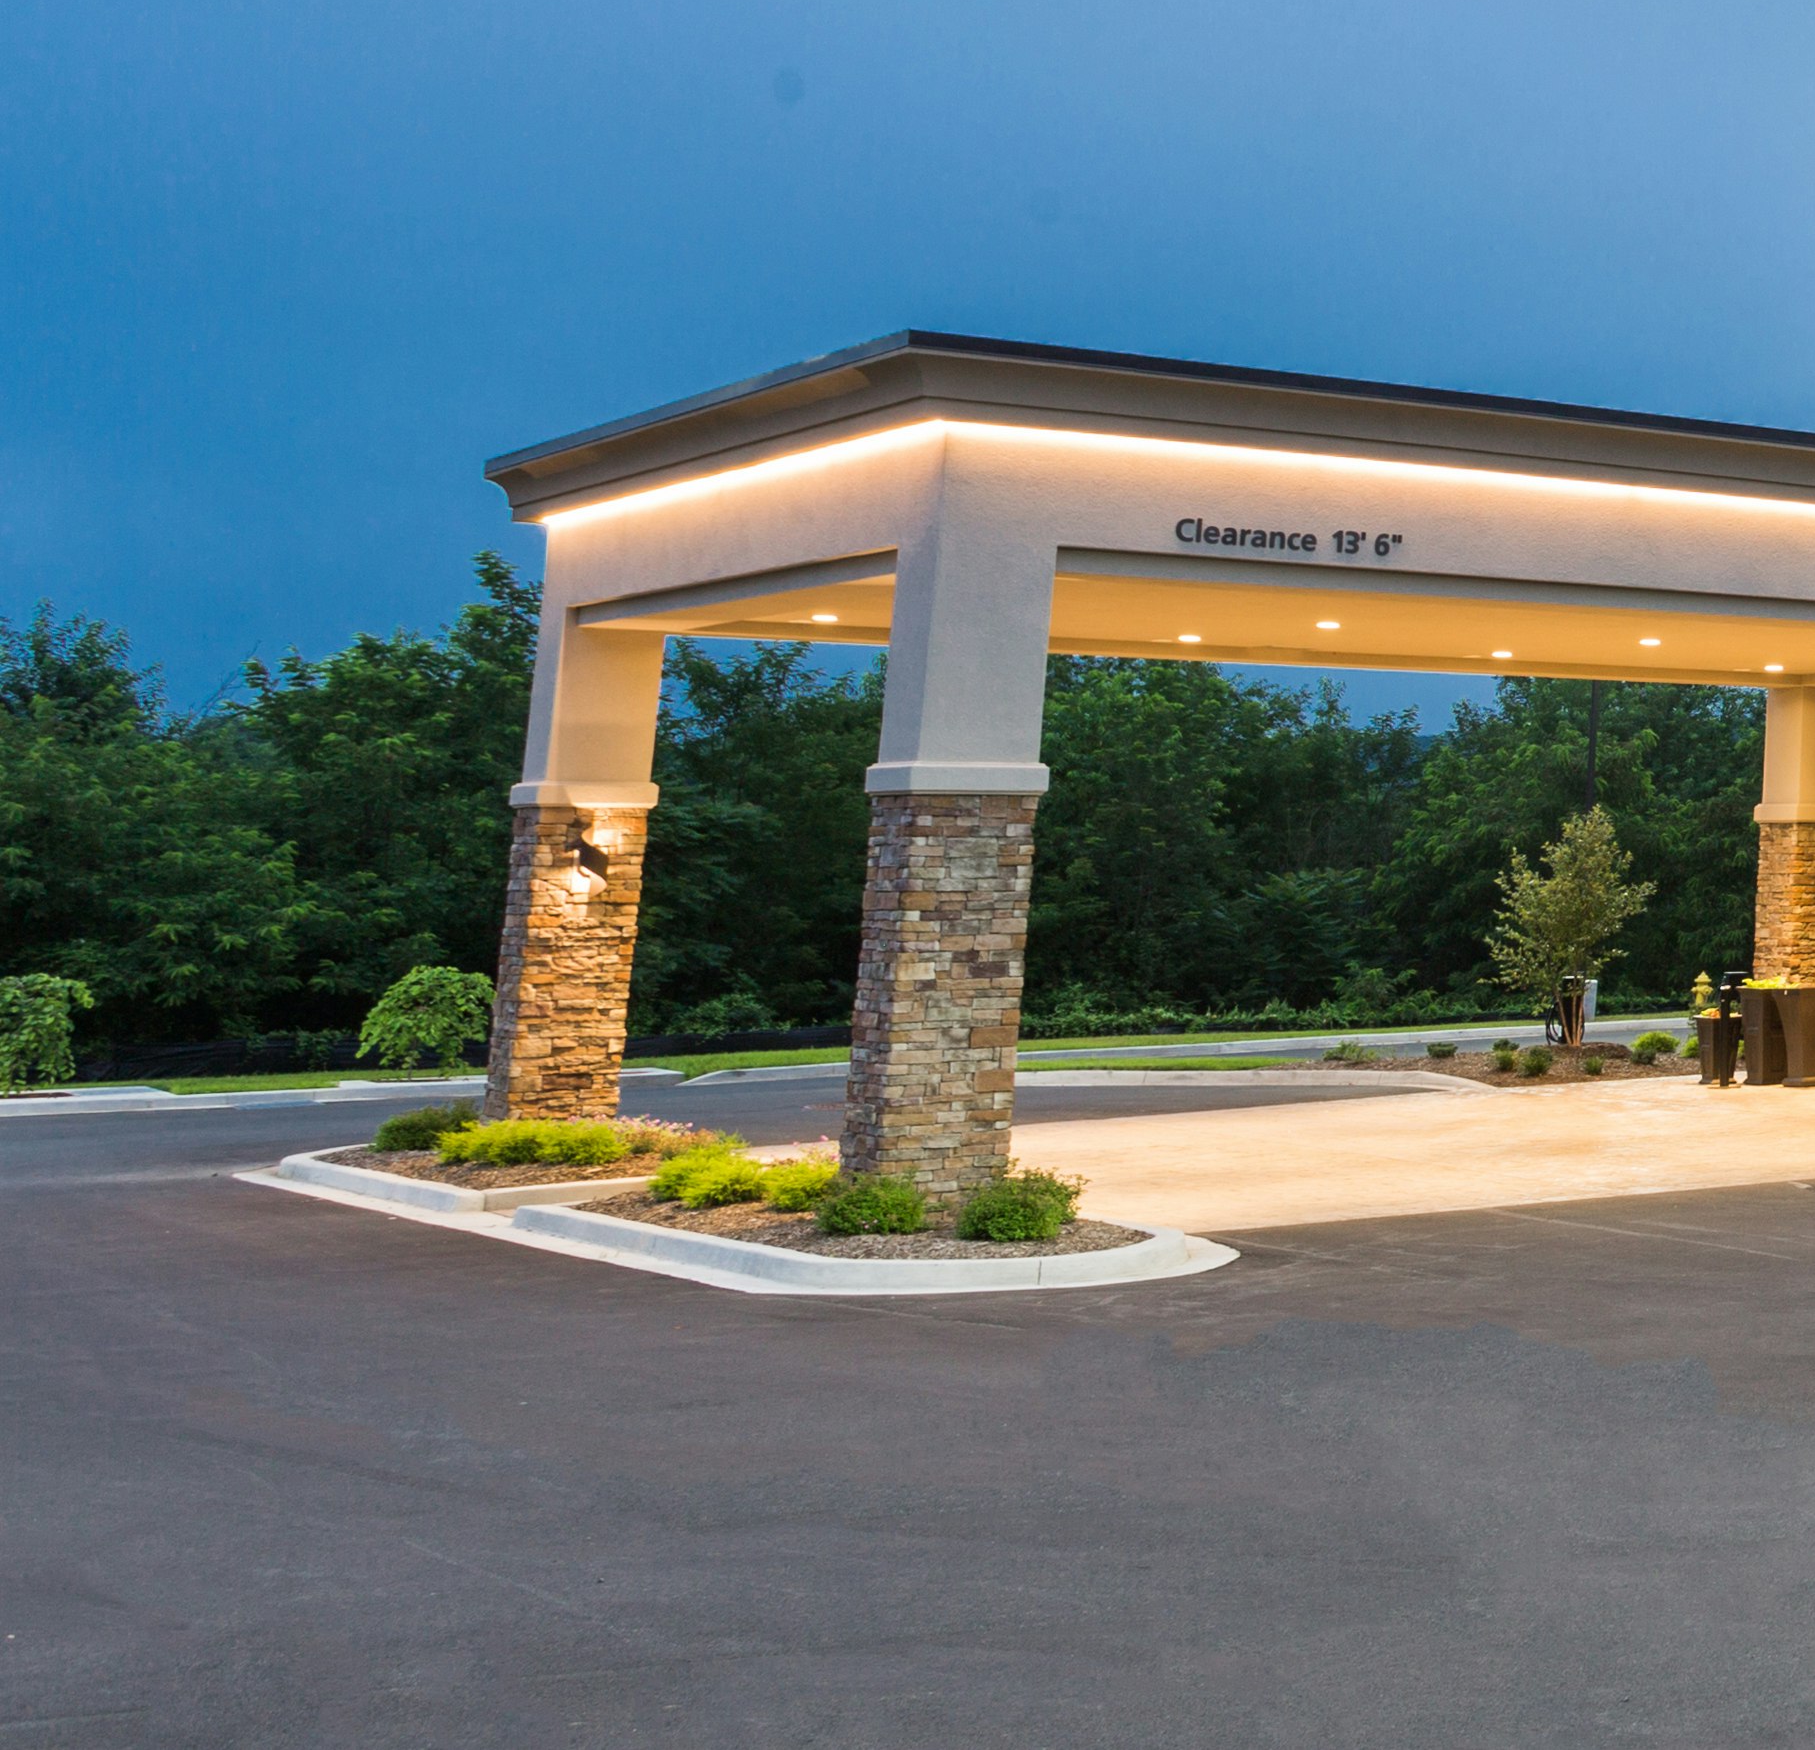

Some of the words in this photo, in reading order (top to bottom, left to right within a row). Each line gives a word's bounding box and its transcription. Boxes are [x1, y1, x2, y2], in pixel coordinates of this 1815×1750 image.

[1175, 517, 1318, 552] Clearance
[1332, 529, 1367, 555] 13'
[1374, 533, 1403, 557] 6"
